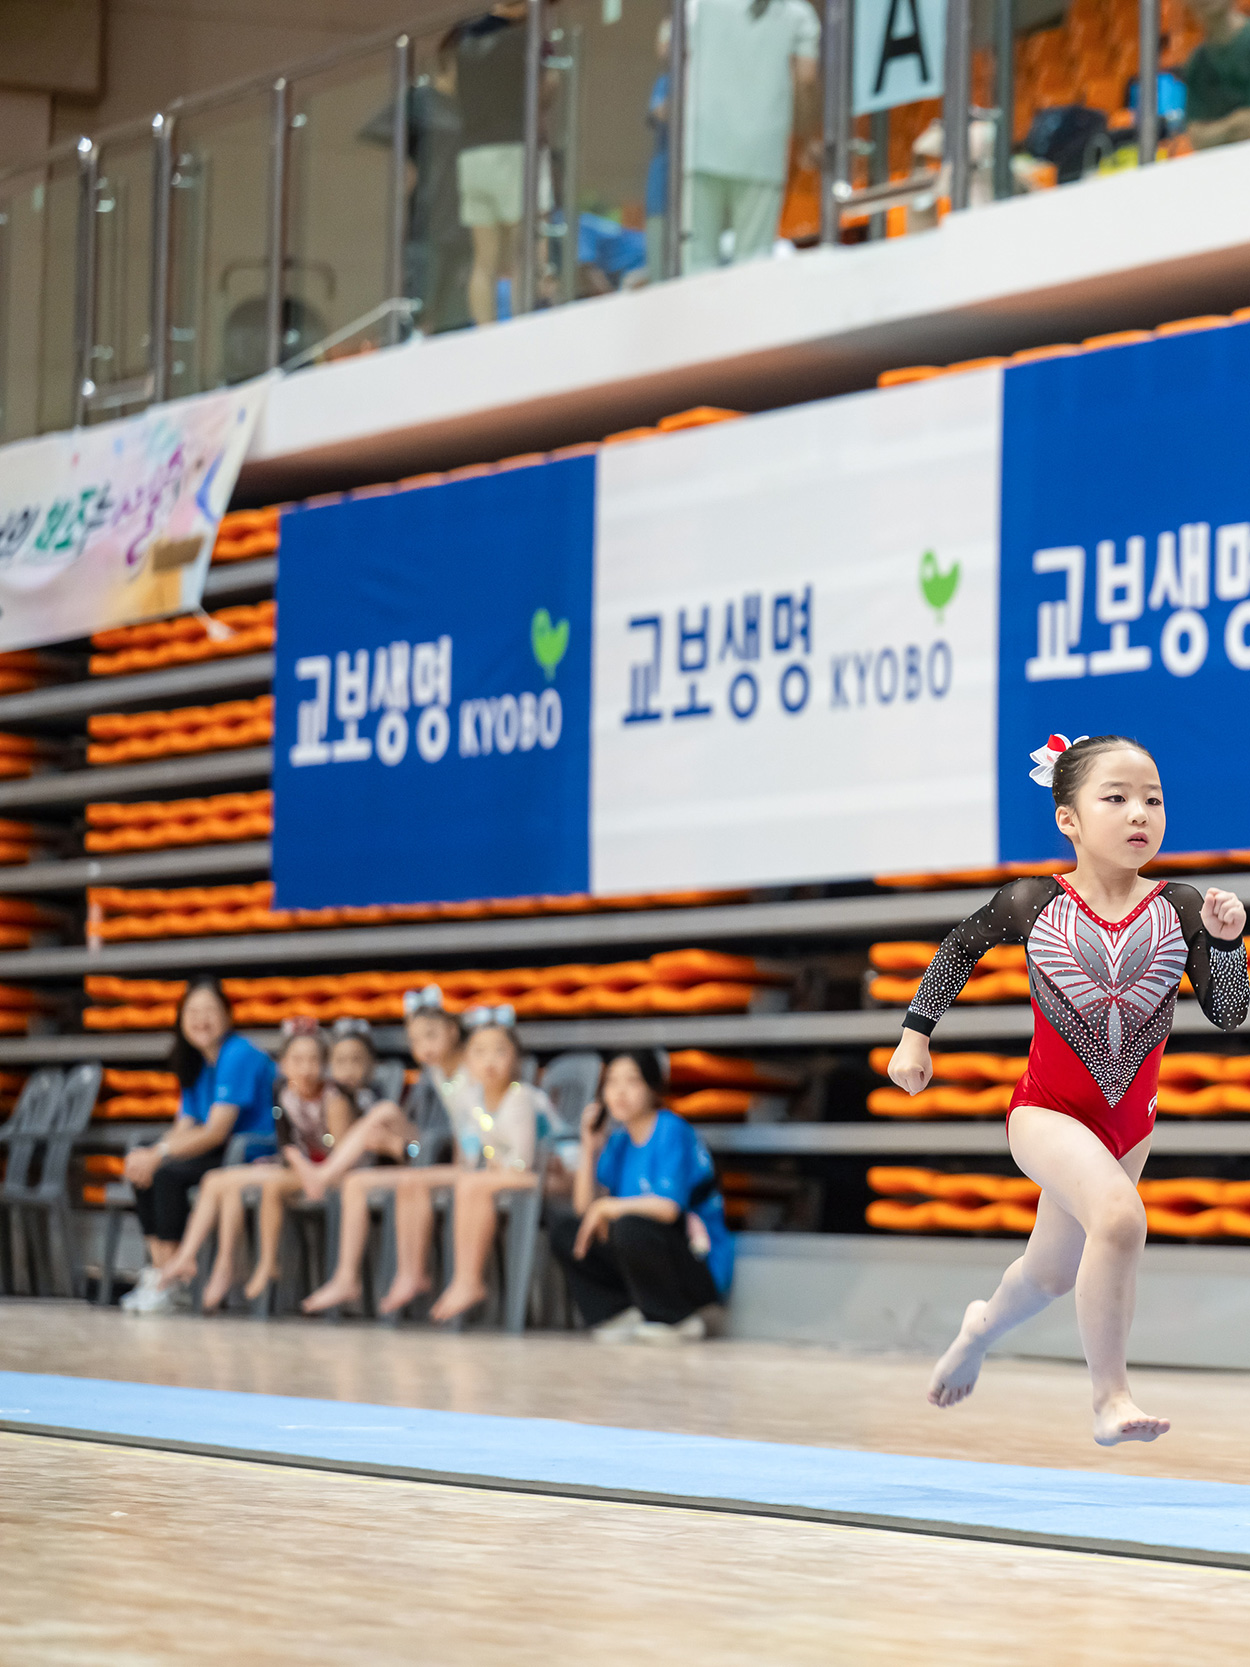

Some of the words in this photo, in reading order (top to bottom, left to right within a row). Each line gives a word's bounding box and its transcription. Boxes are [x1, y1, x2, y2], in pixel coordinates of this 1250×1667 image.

[872, 0, 930, 96] A
[289, 635, 453, 767] 교보생명
[459, 688, 563, 758] KYOBO
[621, 582, 813, 727] 교보생명
[829, 640, 953, 711] KYOBO
